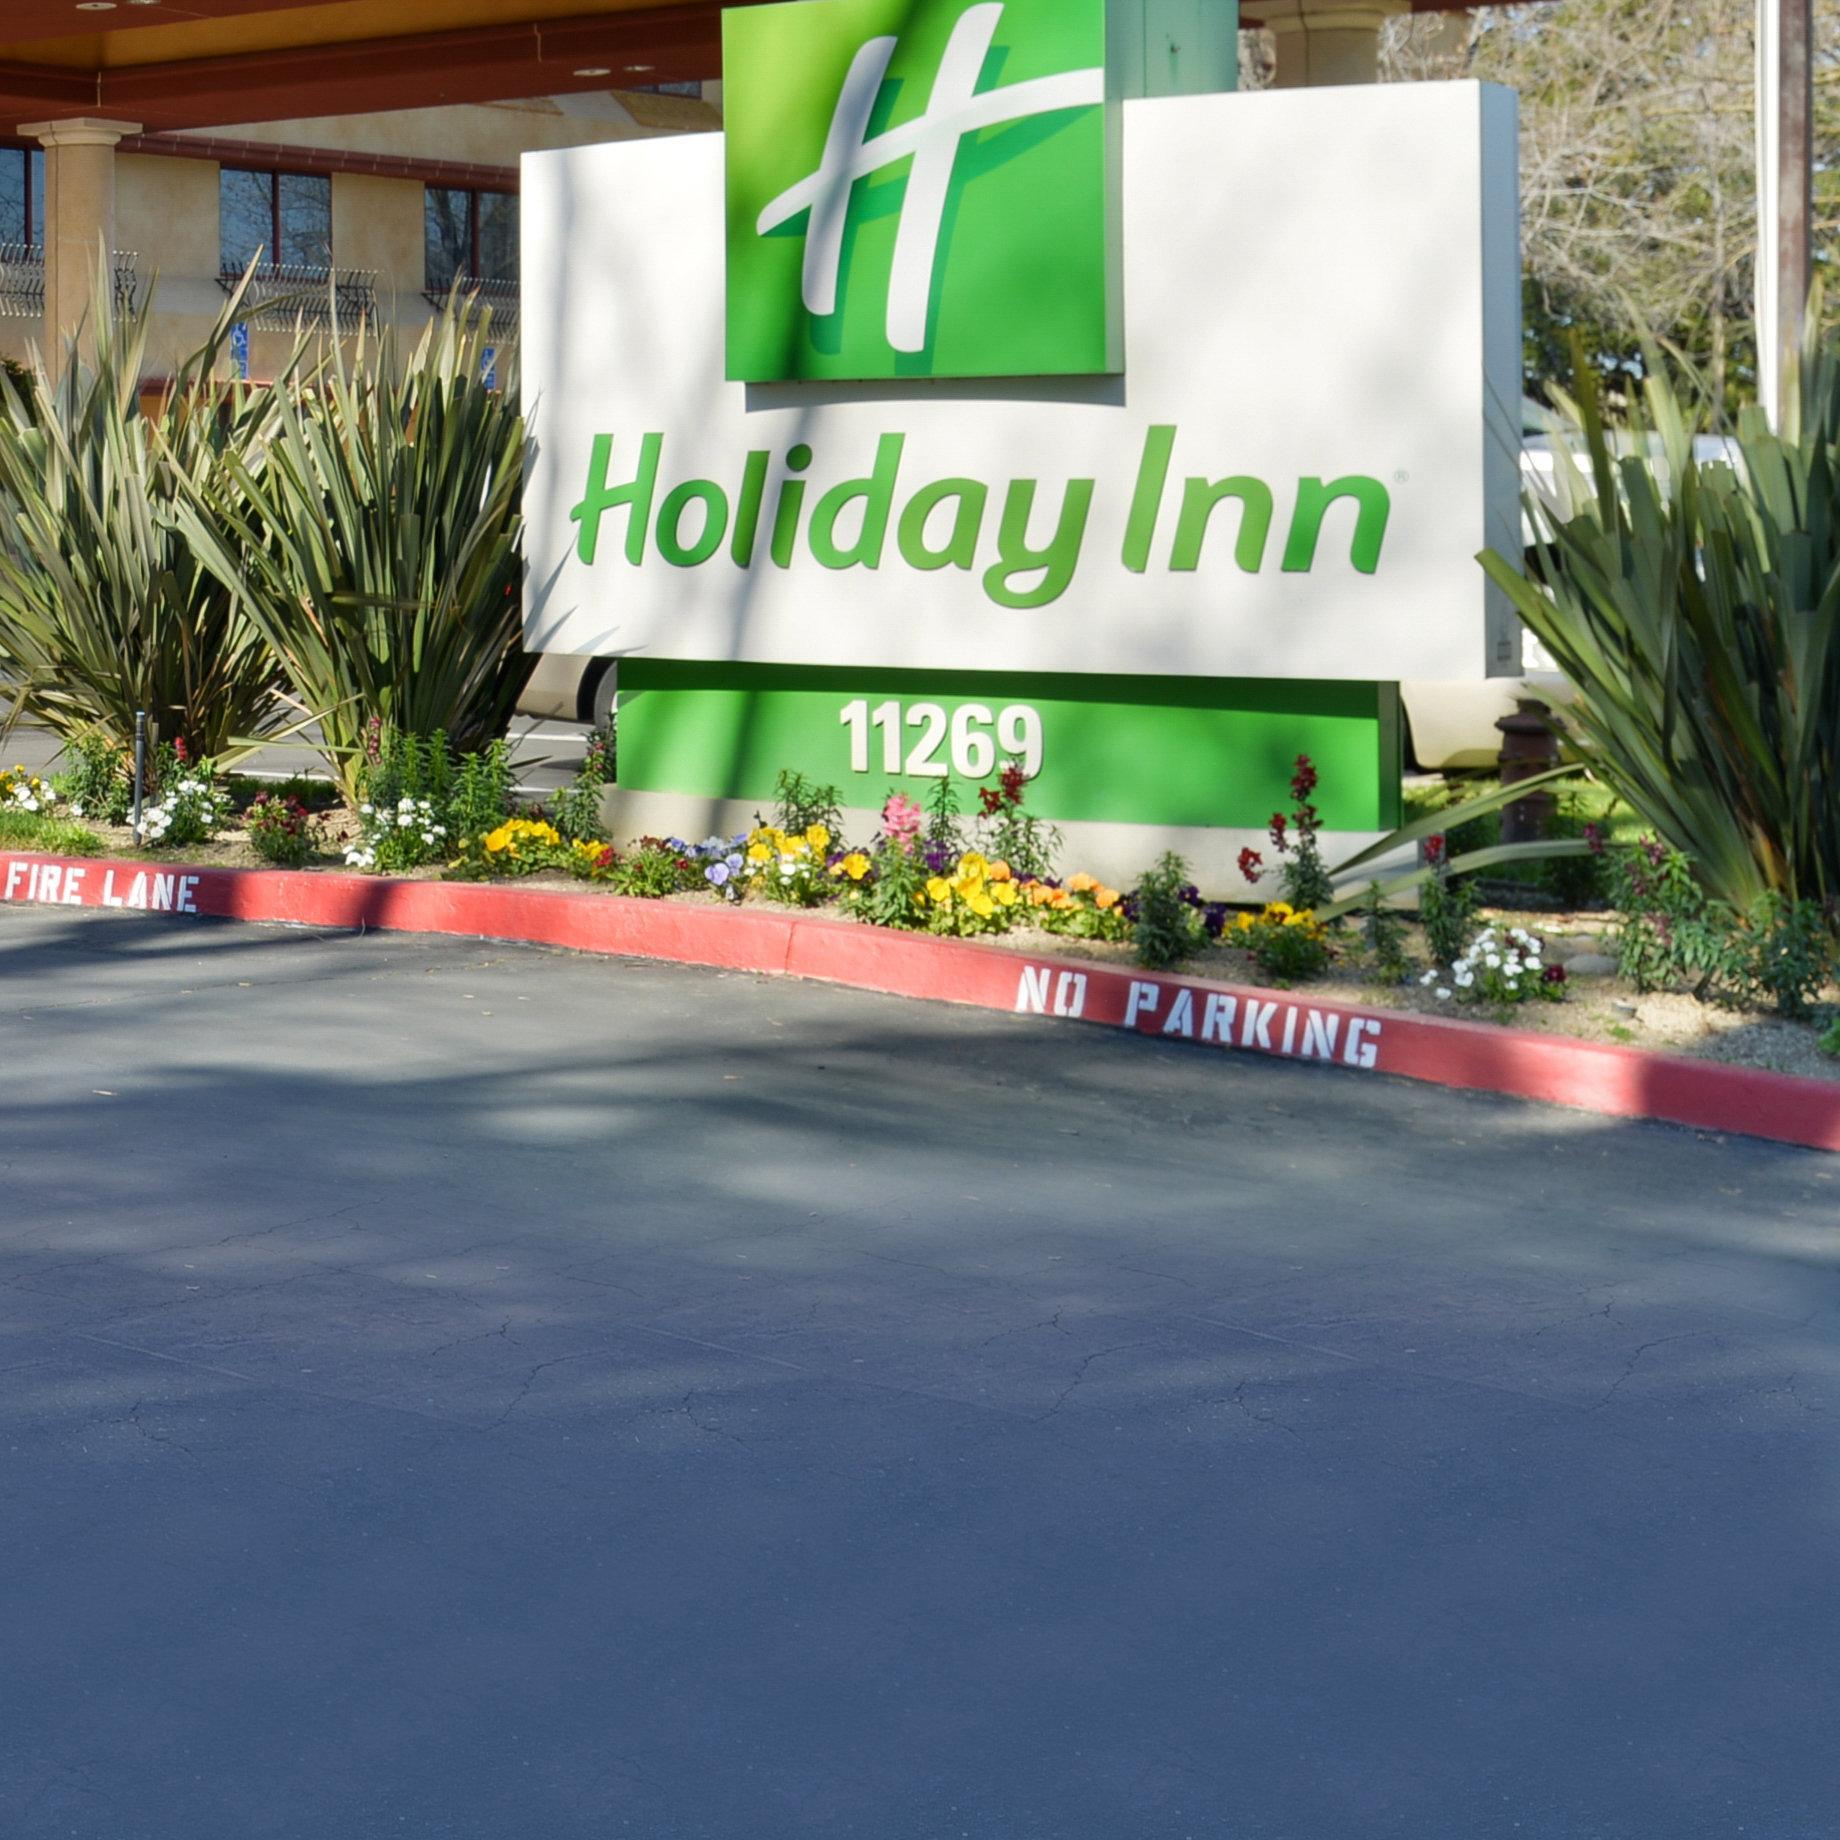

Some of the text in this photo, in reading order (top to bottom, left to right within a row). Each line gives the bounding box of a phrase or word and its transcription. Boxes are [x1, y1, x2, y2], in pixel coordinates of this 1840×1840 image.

[569, 424, 1392, 610] Holiday Inn
[839, 699, 1044, 781] 11269
[4, 861, 200, 913] FIRE LANE
[1015, 965, 1383, 1068] NO PARKING
